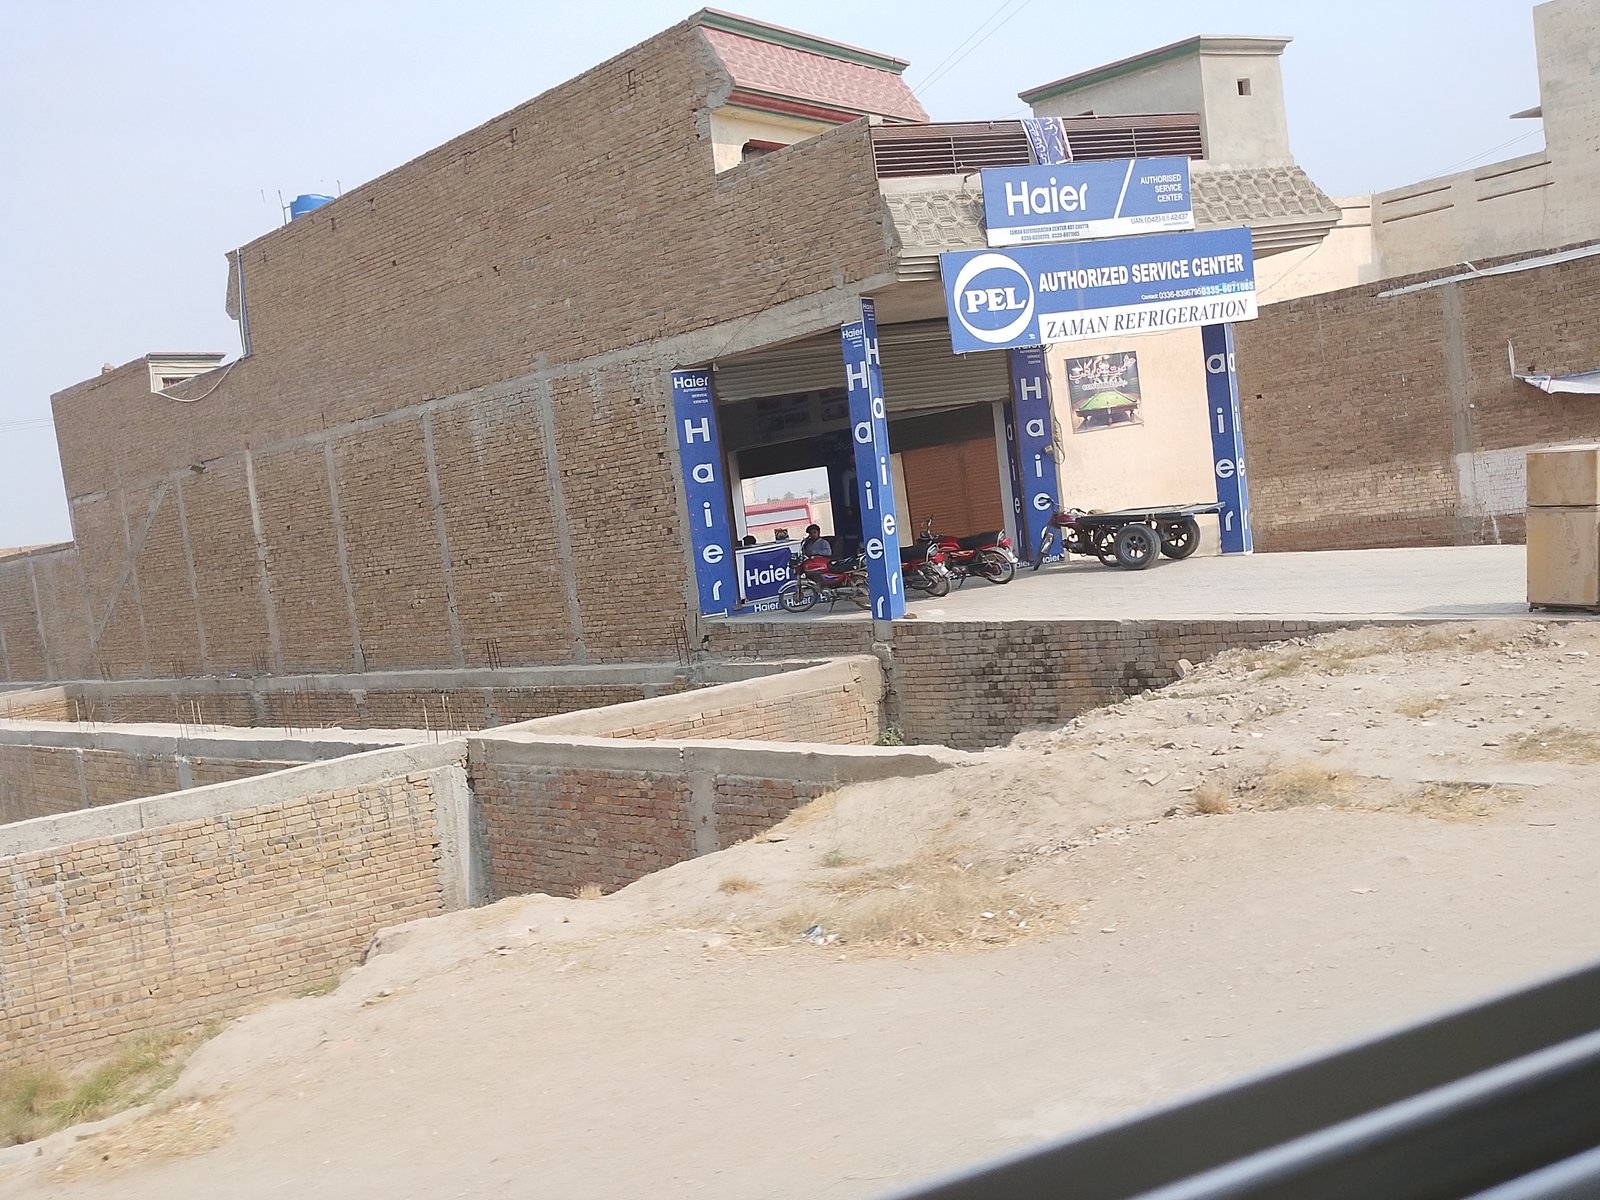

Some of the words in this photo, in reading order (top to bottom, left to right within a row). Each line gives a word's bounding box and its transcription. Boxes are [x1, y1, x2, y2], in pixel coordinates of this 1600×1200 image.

[1140, 174, 1182, 185] AUTHORISED
[1154, 184, 1183, 193] SERVICE
[1005, 177, 1088, 216] Haier
[1157, 193, 1184, 203] CENTER
[1039, 265, 1130, 293] AUTHORIZED
[1131, 259, 1190, 284] SERVICE
[1192, 253, 1245, 277] CENTER
[964, 287, 1026, 314] PEL
[1046, 315, 1109, 340] ZAMAN
[1113, 299, 1248, 332] REFRIGERATION
[842, 328, 863, 340] Haier
[673, 374, 709, 389] Haier
[1206, 353, 1236, 532] aier
[684, 417, 725, 601] Haier
[746, 564, 790, 588] Haier
[754, 601, 780, 613] Haier
